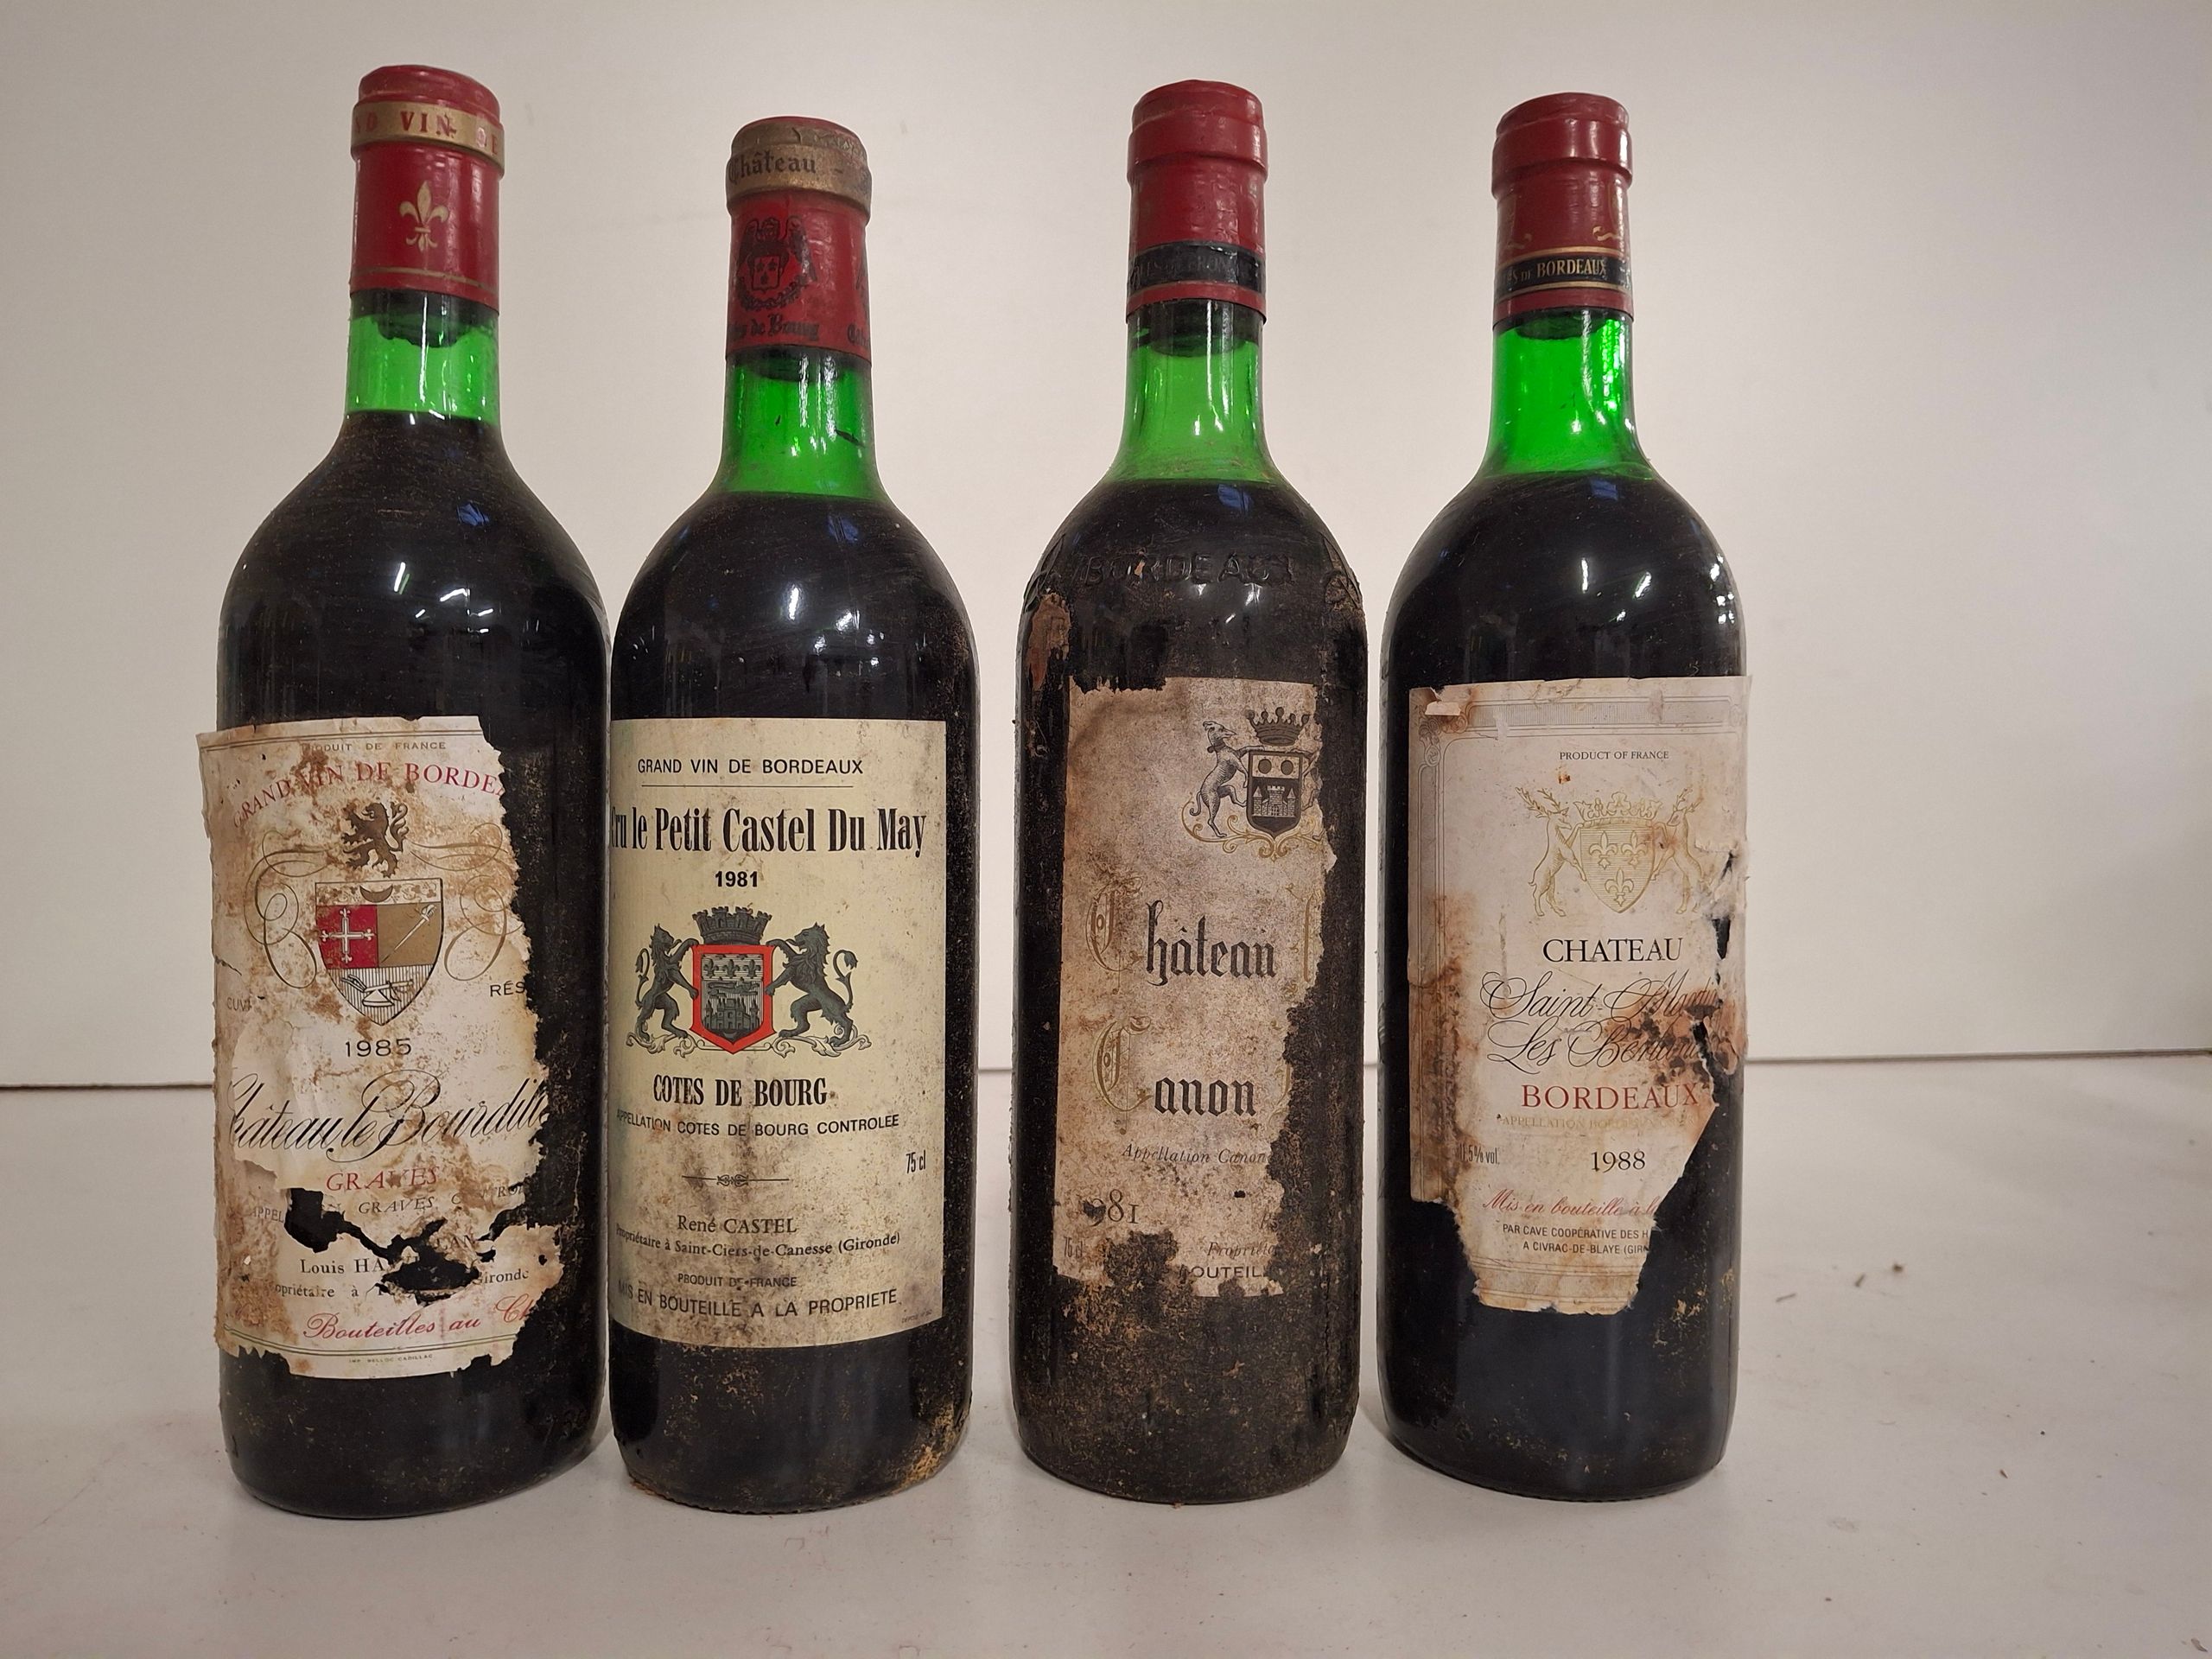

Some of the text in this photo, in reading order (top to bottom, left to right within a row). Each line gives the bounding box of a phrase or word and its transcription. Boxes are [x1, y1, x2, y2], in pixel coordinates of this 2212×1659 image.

[400, 111, 454, 137] VIN
[728, 149, 817, 185] Château
[1536, 258, 1607, 278] BORDEAUX
[365, 742, 383, 751] DE
[395, 741, 447, 751] FRANCE
[1559, 750, 1669, 760] PRODUCT OF FRANCE
[638, 759, 863, 774] GRAND VIN DE BORDEAUX
[233, 779, 292, 828] GRAND
[295, 765, 344, 793] VIN
[355, 761, 391, 782] DE
[632, 806, 648, 849] le
[655, 807, 712, 851] Petit
[722, 807, 816, 852] Castel
[828, 808, 866, 852] Du
[877, 808, 927, 858] May
[715, 870, 758, 887] 1981
[1542, 938, 1683, 963] CHATEAU
[346, 1038, 412, 1058] 1985
[1487, 1015, 1562, 1075] Les
[1092, 1015, 1256, 1134] Canon
[653, 1074, 827, 1107] COTES DE BOURG
[1522, 1083, 1699, 1109] BORDEAUX
[341, 1095, 378, 1147] le
[616, 1109, 899, 1136] APPELLATION COTES DE BOURG CONTROLEE
[906, 1150, 926, 1174] 75 cl
[1122, 1143, 1210, 1163] Appellation
[1592, 1150, 1646, 1173] 1988
[327, 1166, 440, 1191] GRAVES
[359, 1196, 435, 1214] GRAVES
[1482, 1188, 1518, 1211] Mis
[1524, 1203, 1544, 1213] en
[1550, 1196, 1623, 1217] bouteille
[1628, 1199, 1641, 1216] à
[677, 1214, 798, 1234] René CASTEL
[1503, 1224, 1520, 1235] PAR
[1522, 1225, 1548, 1236] CAVE
[1620, 1229, 1639, 1239] DES
[664, 1238, 671, 1251] à
[838, 1232, 900, 1254] (Gironde)
[1522, 1242, 1529, 1250] A
[1533, 1242, 1620, 1254] CIVRAC-DE-BLAYE
[300, 1258, 345, 1274] Louis
[275, 1282, 335, 1298] opriétaire
[351, 1285, 359, 1297] à
[677, 1273, 798, 1287] PRODUIT DE FRANCE
[638, 1288, 652, 1306] EN
[659, 1294, 741, 1317] BOUTEILLE
[751, 1302, 764, 1318] A
[775, 1302, 798, 1317] LA
[808, 1288, 898, 1315] PROPRIETE
[302, 1310, 435, 1339] Bouteilles
[448, 1317, 481, 1331] au
